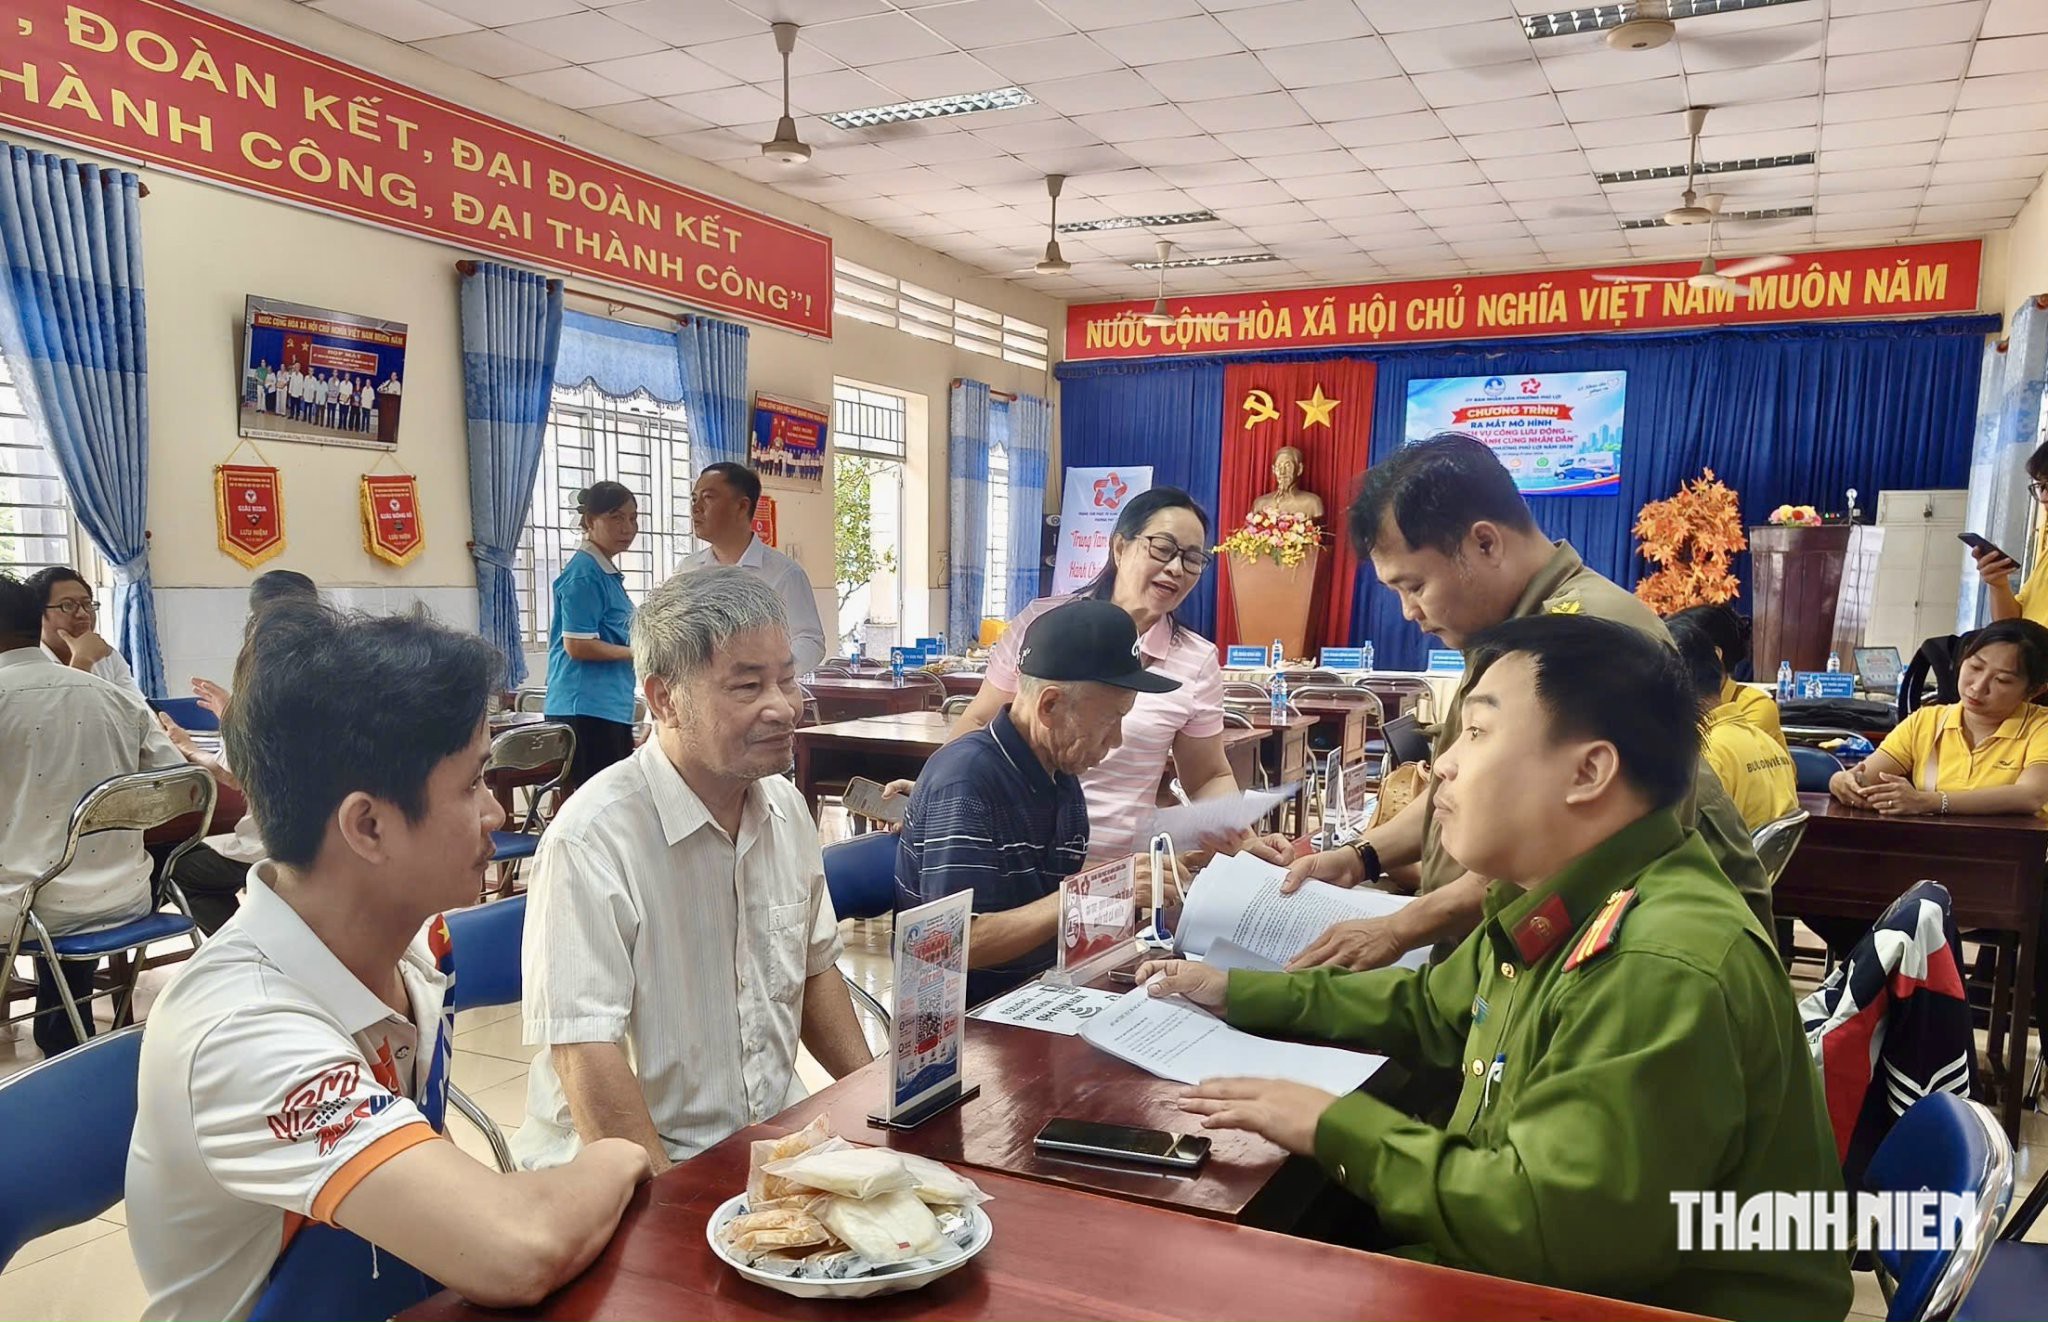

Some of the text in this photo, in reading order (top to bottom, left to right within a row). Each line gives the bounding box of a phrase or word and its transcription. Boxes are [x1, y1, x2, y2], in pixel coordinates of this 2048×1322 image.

[63, 5, 279, 110] ĐOÀN
[451, 137, 533, 189] ĐẠI
[547, 168, 662, 231] ĐOÀN
[675, 212, 743, 255] KẾT
[452, 191, 533, 241] ĐẠI
[546, 218, 684, 283] THÀNH
[1086, 258, 1948, 351] NƯỚC CỘNG HÒA XÃ HỘI CHỦ NGHĨA VIỆT NAM MUÔN NĂM
[1467, 404, 1560, 418] CHƯƠNG TRÌNH
[1485, 419, 1506, 428] MẮT
[1508, 420, 1525, 428] MÔ
[1527, 418, 1552, 427] HÌNH
[1493, 427, 1518, 436] CÔNG
[1520, 428, 1538, 436] LƯU
[1539, 426, 1566, 436] ĐỘNG
[1528, 434, 1555, 443] NHÂN
